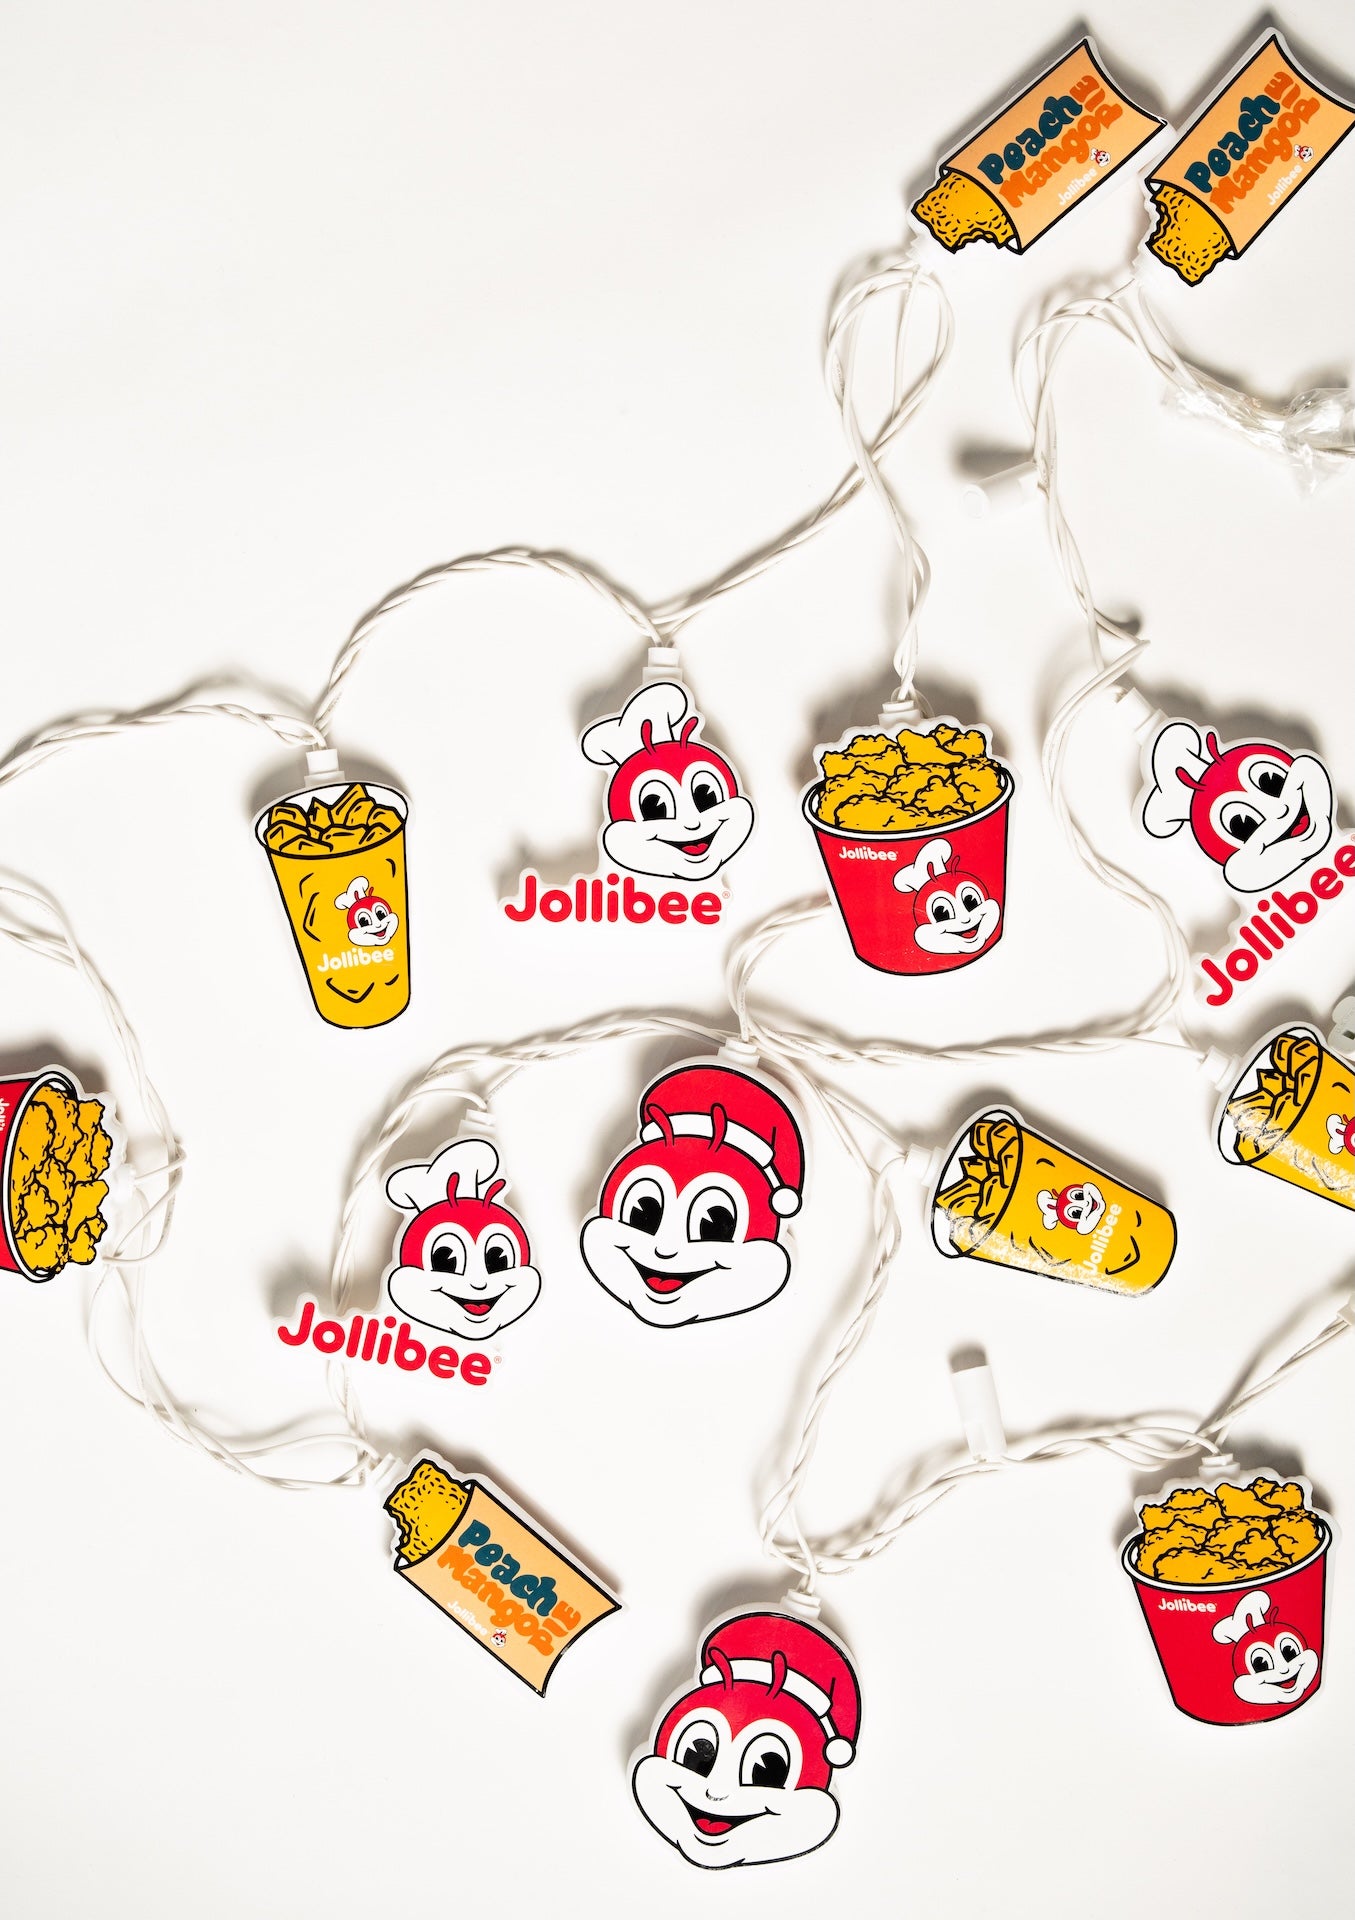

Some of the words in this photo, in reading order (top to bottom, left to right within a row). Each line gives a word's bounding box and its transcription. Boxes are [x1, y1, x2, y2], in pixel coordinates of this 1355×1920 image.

[977, 95, 1082, 185] Peach
[999, 115, 1101, 208] Mango
[1184, 94, 1280, 193] Peach
[1210, 112, 1301, 214] Mango
[1057, 168, 1097, 206] Jollibee
[1267, 164, 1303, 206] Jollibee
[838, 846, 897, 861] Jollibee
[504, 873, 722, 924] Jollibee
[317, 947, 394, 972] Jollibee
[1082, 1203, 1122, 1275] Jollibee
[277, 1302, 492, 1386] Jollibee
[437, 1544, 539, 1636] Mango
[457, 1519, 558, 1617] Peach
[447, 1601, 488, 1636] Jollibee
[1158, 1597, 1216, 1613] Jollibee
